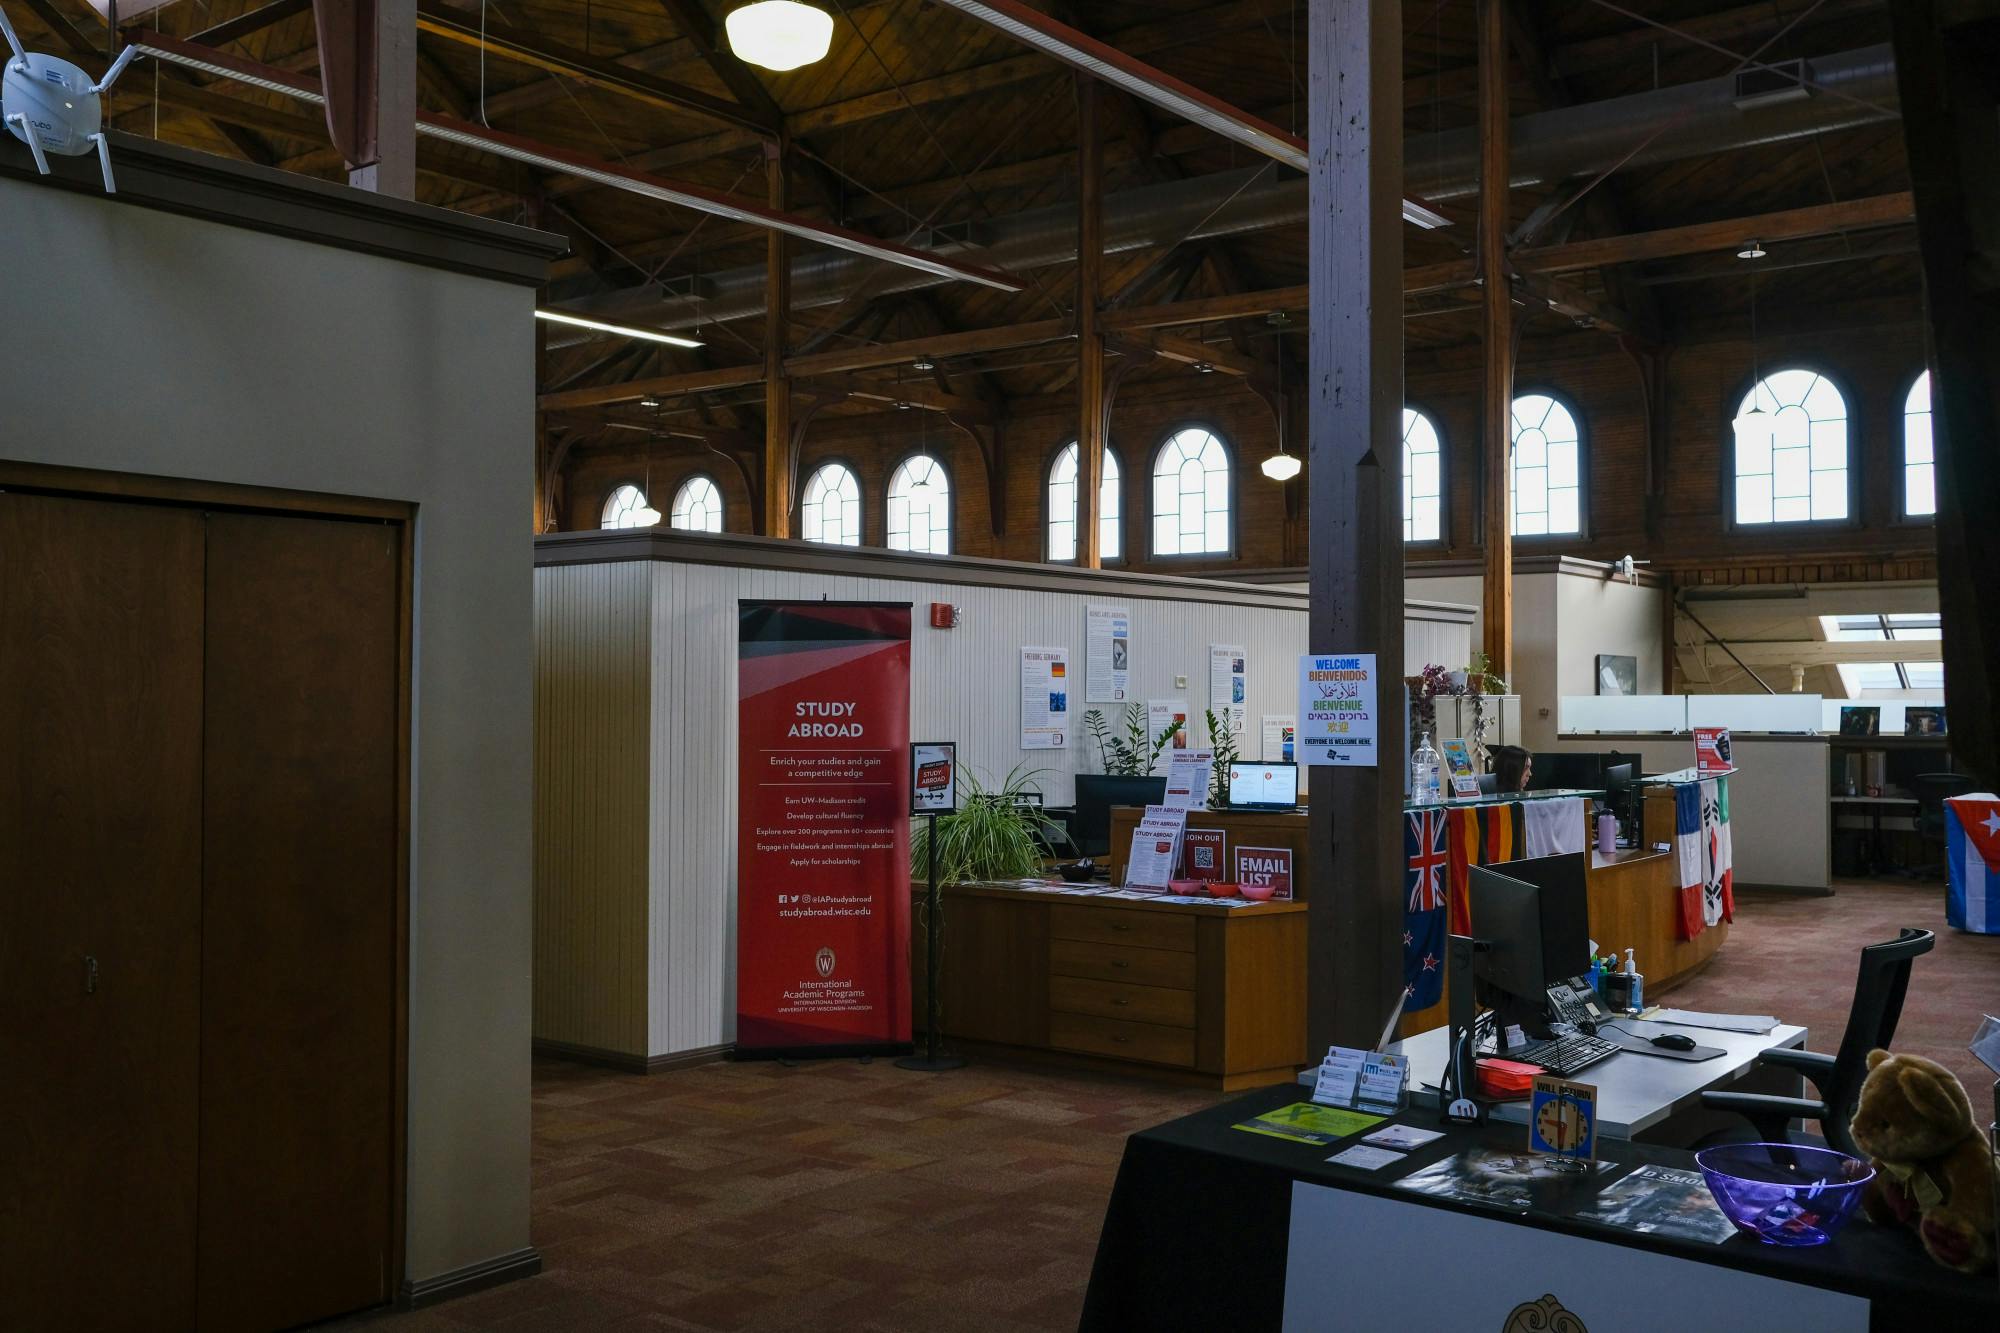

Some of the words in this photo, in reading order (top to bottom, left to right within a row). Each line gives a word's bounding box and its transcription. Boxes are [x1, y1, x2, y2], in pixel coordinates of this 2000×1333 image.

[1316, 659, 1360, 670] WELCOME
[1309, 671, 1367, 681] BIENVENIDOS
[796, 702, 856, 716] STUDY
[1313, 700, 1363, 711] BIENVENUE
[788, 723, 864, 737] ABROAD
[770, 757, 796, 765] Enrich
[817, 757, 845, 765] studies
[847, 757, 862, 765] and
[864, 757, 880, 767] gain
[794, 769, 841, 778] competitive
[843, 768, 864, 778] edge
[923, 769, 942, 778] STUDY
[921, 776, 946, 784] ABROAD
[787, 812, 814, 820] Develop
[841, 812, 865, 820] fluency
[756, 828, 781, 836] Explore
[812, 829, 843, 837] programs
[757, 843, 782, 852] Engage
[834, 843, 870, 851] internships
[790, 858, 810, 866] Apply
[821, 858, 861, 866] scholarships
[1240, 857, 1289, 874] EMAIL
[1240, 872, 1272, 886] LIST
[812, 895, 872, 905] @IAPstudyabroad
[779, 907, 871, 918] studyabroad.wisc.edu
[799, 980, 852, 989] International
[783, 990, 824, 999] Academic
[826, 989, 865, 998] Programs
[1536, 1081, 1555, 1094] WILL
[1559, 1086, 1591, 1100] RETURN
